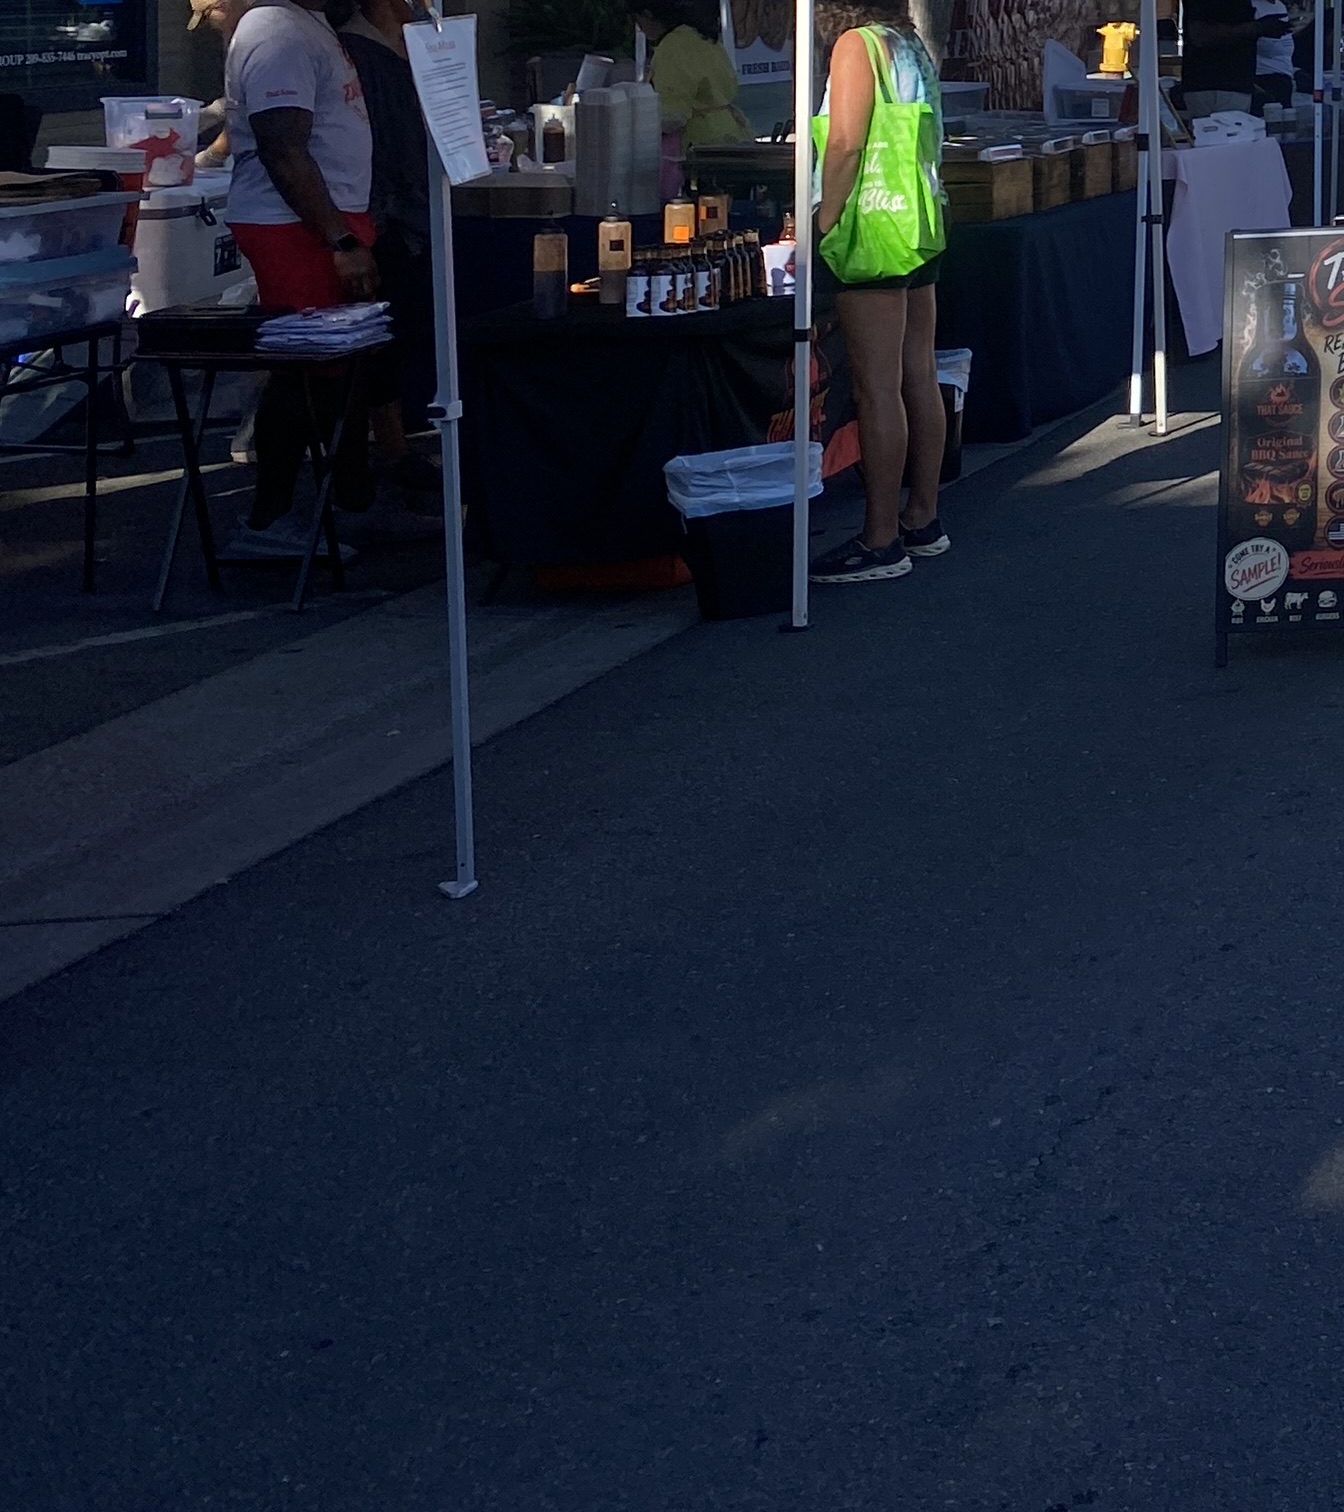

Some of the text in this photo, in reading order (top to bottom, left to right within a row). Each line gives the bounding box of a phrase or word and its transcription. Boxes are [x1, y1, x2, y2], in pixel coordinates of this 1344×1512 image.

[1256, 437, 1303, 450] Original
[1251, 449, 1309, 461] BBQ Sauce
[1231, 544, 1271, 565] COME TRY A
[1231, 552, 1282, 590] SAMPLE!
